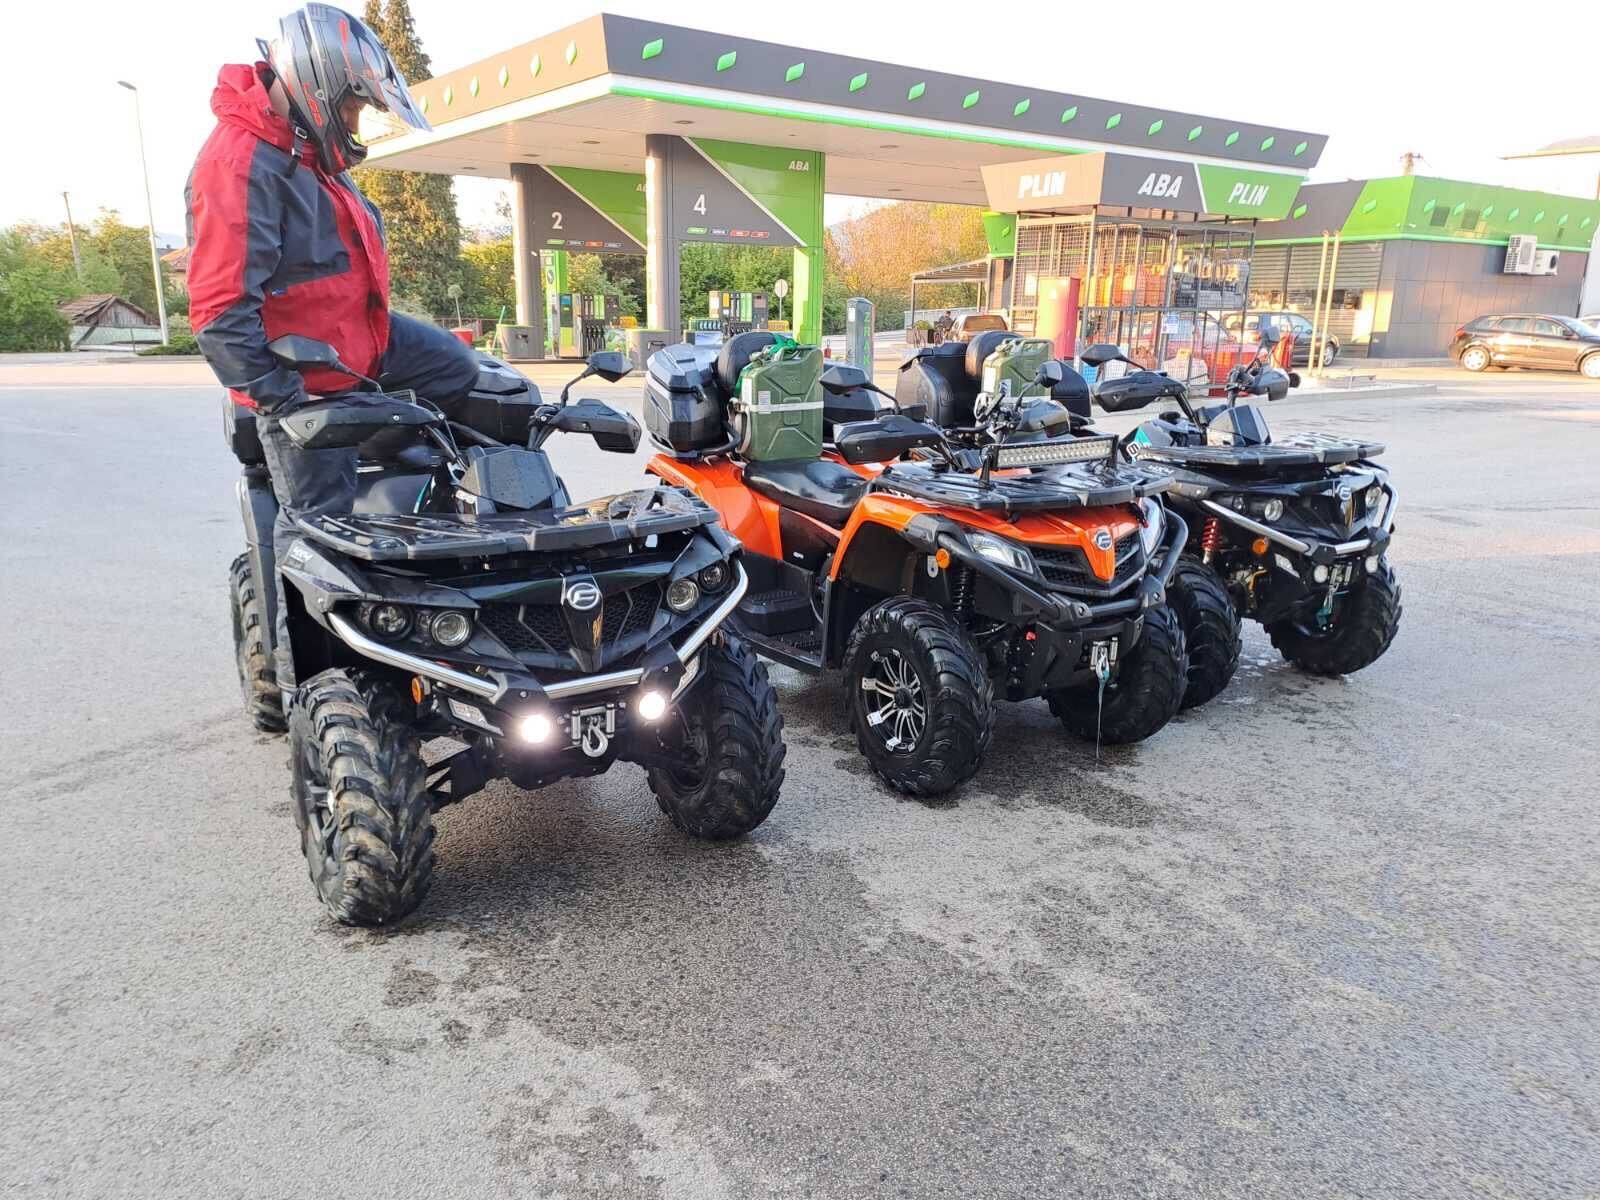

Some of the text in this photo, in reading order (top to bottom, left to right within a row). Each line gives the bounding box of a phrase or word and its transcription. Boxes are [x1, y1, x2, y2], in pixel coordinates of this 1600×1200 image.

[788, 160, 809, 171] ABA
[1017, 171, 1066, 199] PLIN
[1137, 172, 1183, 198] ABA
[1228, 182, 1270, 206] PLIN
[693, 193, 706, 216] 4
[551, 211, 563, 230] 2
[863, 311, 872, 368] ZRAK
